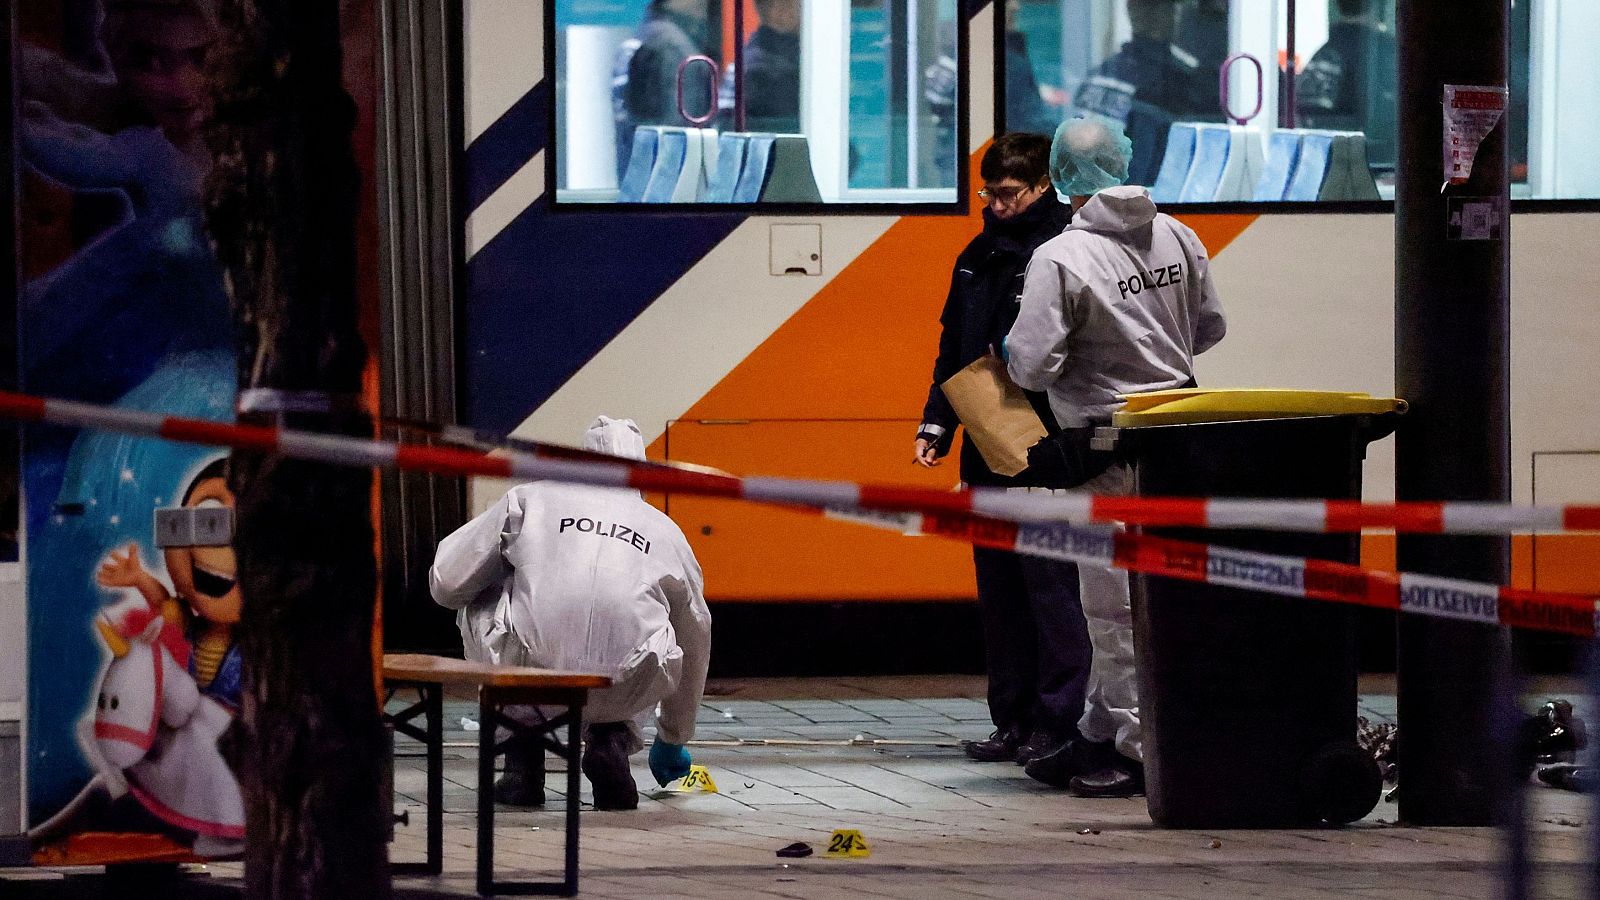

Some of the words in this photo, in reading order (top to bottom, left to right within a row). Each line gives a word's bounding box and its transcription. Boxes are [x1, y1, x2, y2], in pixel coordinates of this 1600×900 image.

[1117, 263, 1183, 300] POLIZEI
[559, 517, 651, 555] POLIZEI
[827, 833, 854, 853] 24
